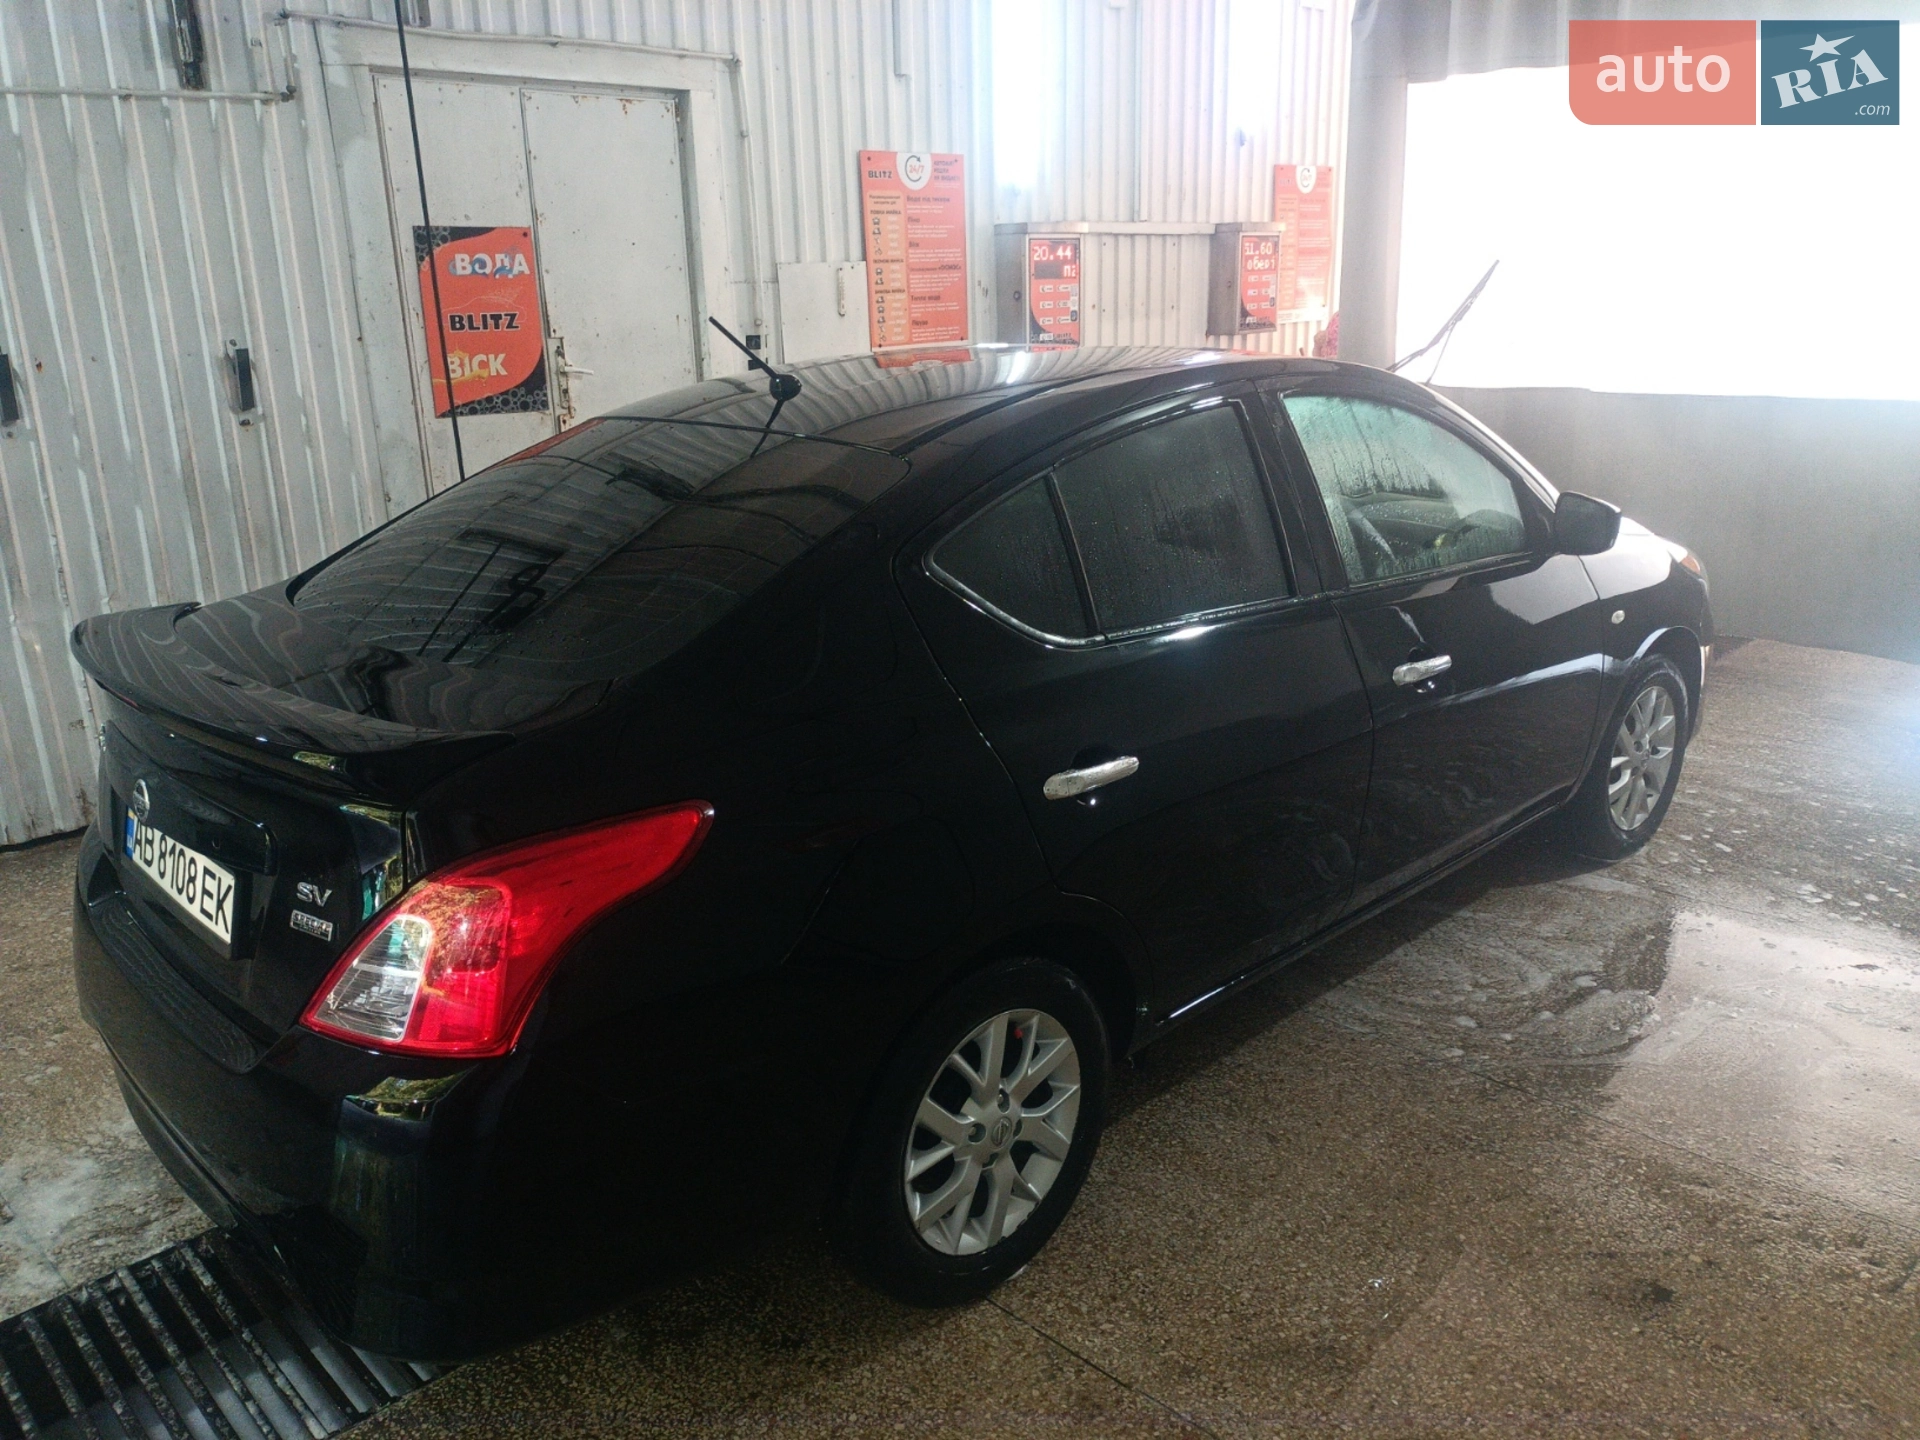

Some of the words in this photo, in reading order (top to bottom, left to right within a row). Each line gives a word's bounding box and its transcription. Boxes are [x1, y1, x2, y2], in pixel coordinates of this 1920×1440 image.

[868, 170, 893, 179] BLITZ
[908, 164, 925, 174] 24/7
[1033, 245, 1072, 261] 20.44
[454, 252, 530, 279] ВОДА
[448, 312, 520, 332] BLITZ
[133, 819, 155, 868] AB
[157, 834, 198, 905] 8108
[200, 865, 233, 935] EK
[296, 881, 333, 907] SV
